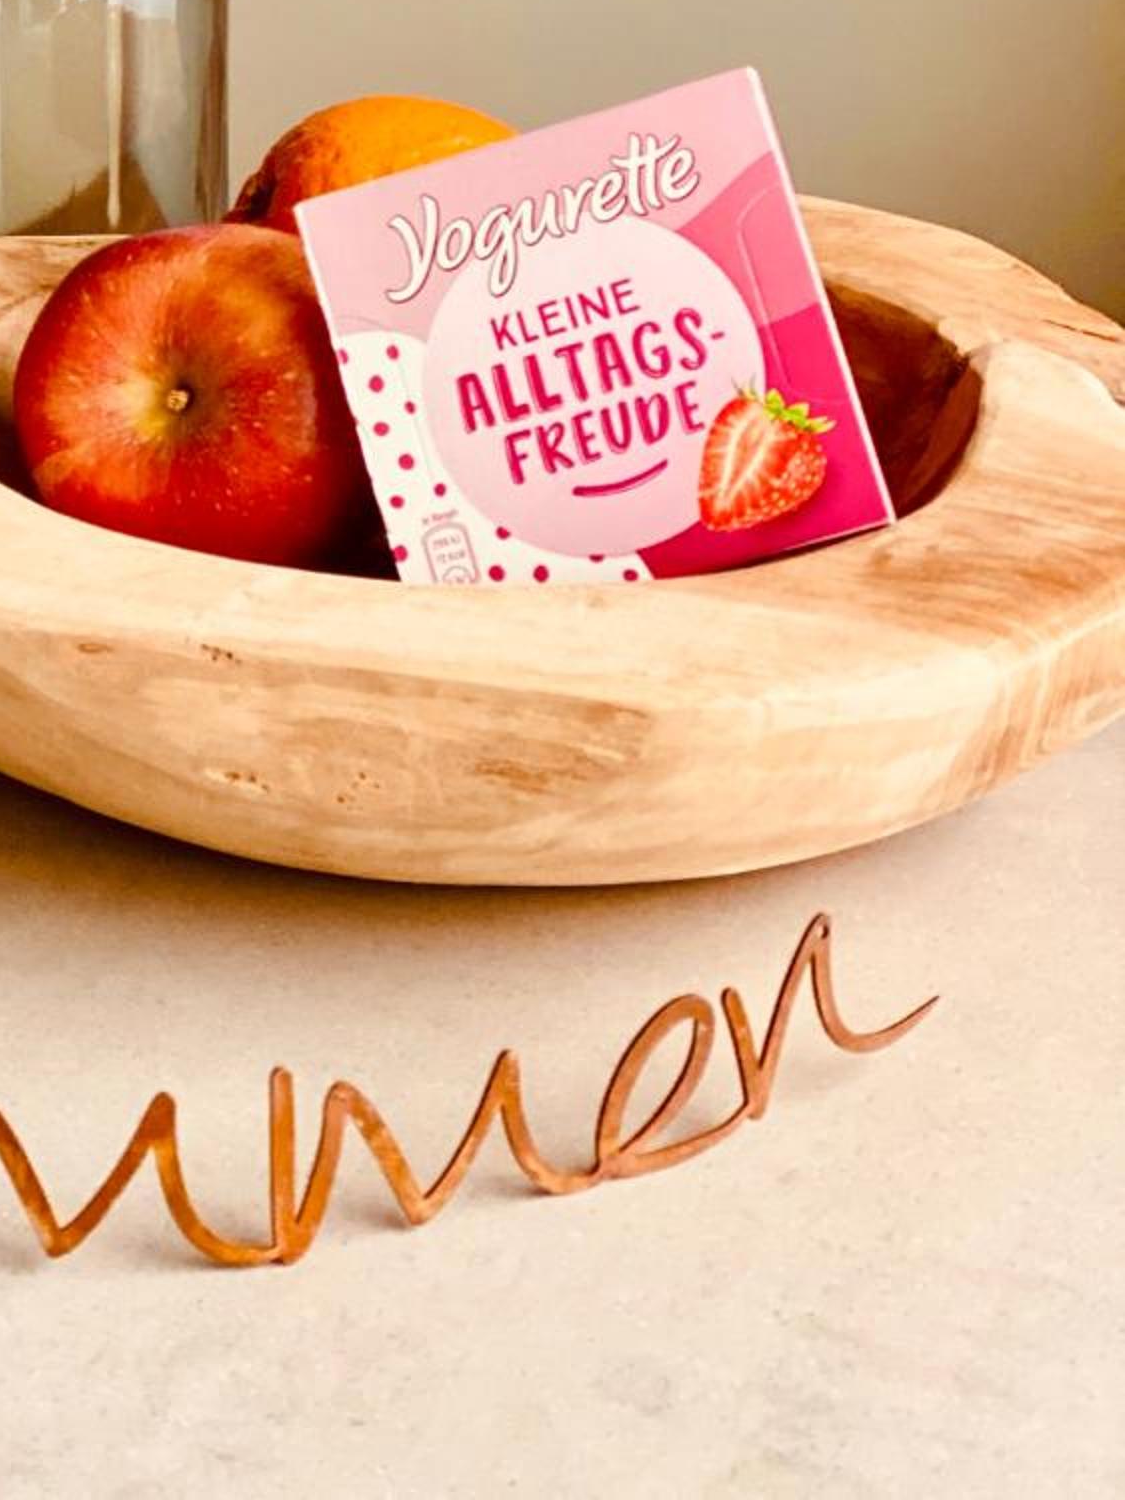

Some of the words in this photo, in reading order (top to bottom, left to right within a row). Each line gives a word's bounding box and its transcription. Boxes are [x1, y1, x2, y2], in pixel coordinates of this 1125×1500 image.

[386, 132, 700, 304] Yogurette
[456, 307, 726, 435] ALLTAGS-
[489, 277, 641, 351] KLEINE
[504, 380, 706, 485] FREUDE
